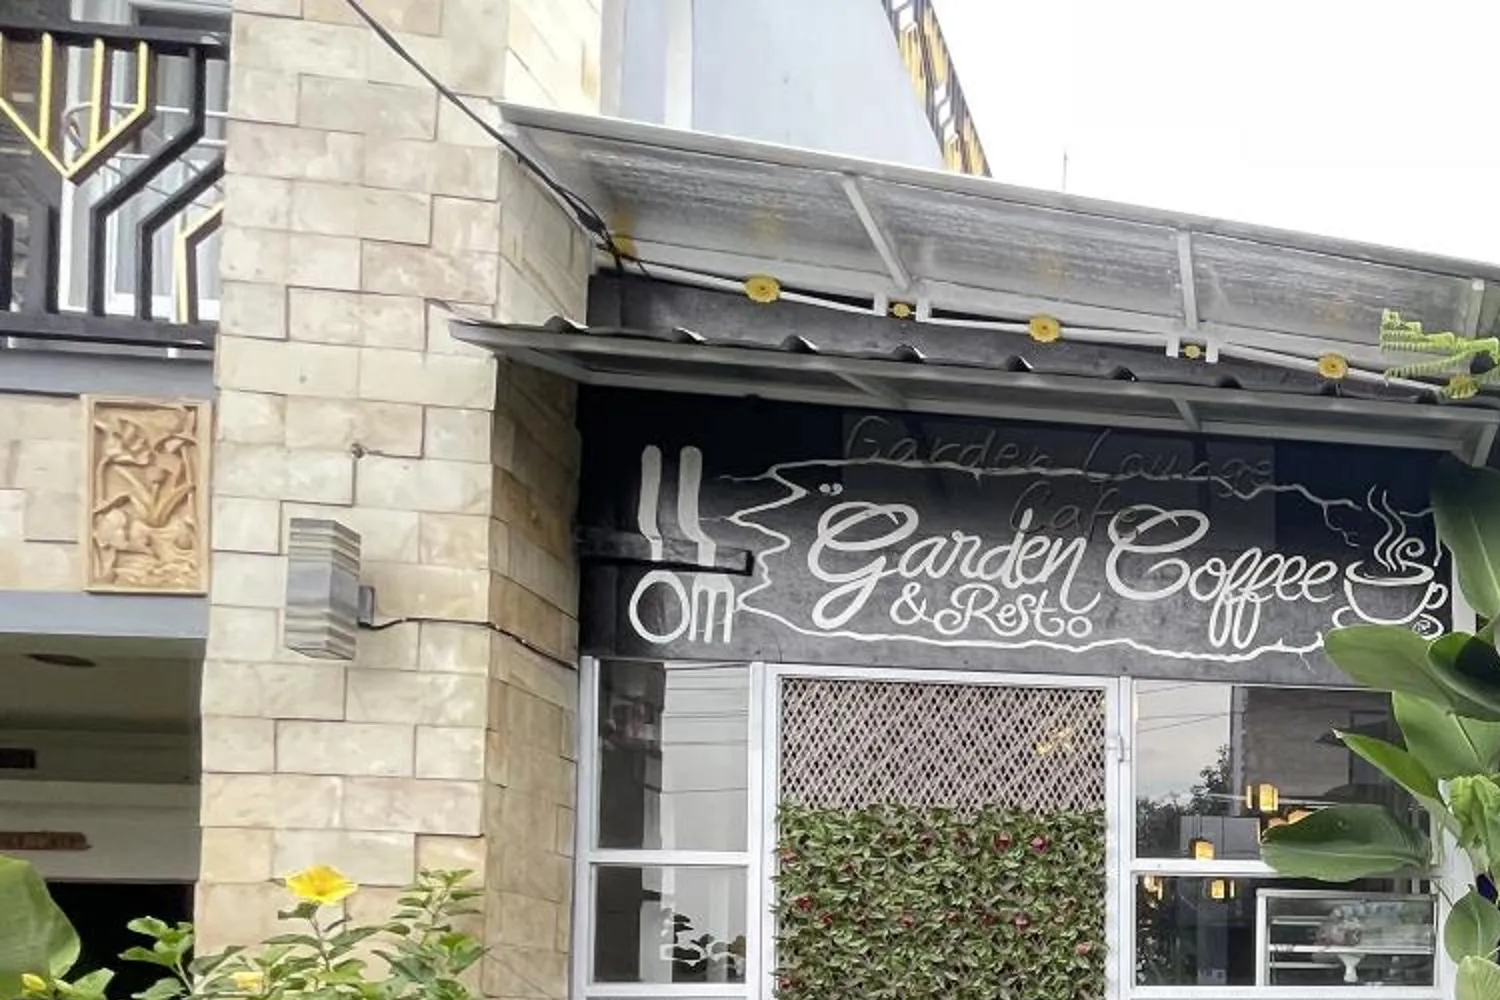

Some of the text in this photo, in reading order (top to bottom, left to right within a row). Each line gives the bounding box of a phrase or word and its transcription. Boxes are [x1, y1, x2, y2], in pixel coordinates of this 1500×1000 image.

[807, 501, 1339, 649] Garden Coffee
[889, 581, 933, 626] &
